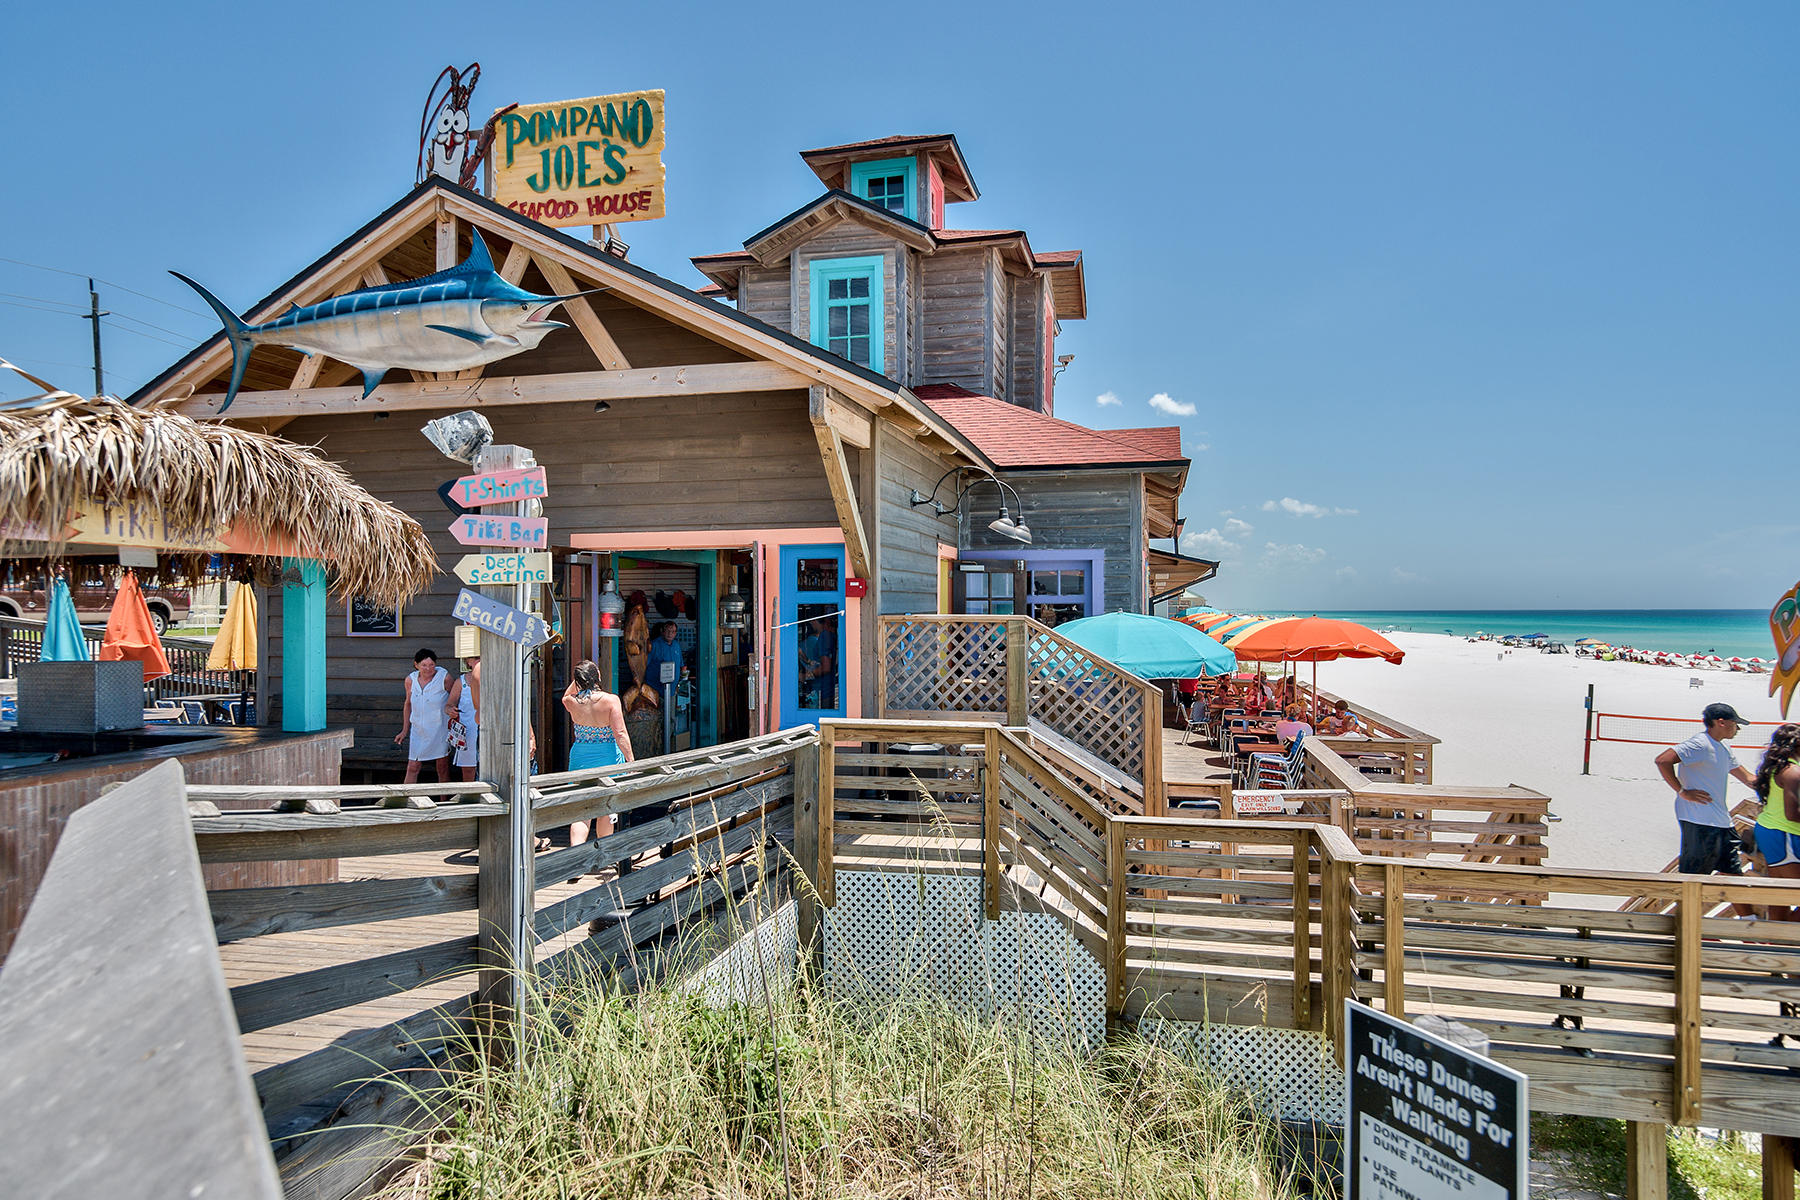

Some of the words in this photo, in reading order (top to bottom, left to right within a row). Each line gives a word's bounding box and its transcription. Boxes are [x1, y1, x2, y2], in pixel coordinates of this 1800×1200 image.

[501, 98, 653, 168] POMPANO
[526, 138, 627, 193] JOE'S
[586, 191, 652, 216] HOUSE
[458, 477, 545, 502] T-Shirts
[510, 521, 545, 542] Bar
[455, 592, 516, 636] Beach
[521, 616, 536, 646] Bar
[1237, 795, 1275, 803] EMERGENCY
[1369, 1032, 1428, 1078] These
[1431, 1060, 1497, 1112] Dunes
[1356, 1054, 1414, 1099] Aren't
[1416, 1080, 1472, 1127] Made
[1475, 1109, 1513, 1148] For
[1391, 1095, 1471, 1161] Walking
[1373, 1122, 1410, 1148] DON'T
[1414, 1143, 1476, 1186] TRAMPLE
[1373, 1135, 1407, 1161] DUNE
[1411, 1155, 1462, 1192] PLANTS
[1373, 1159, 1398, 1181] USE
